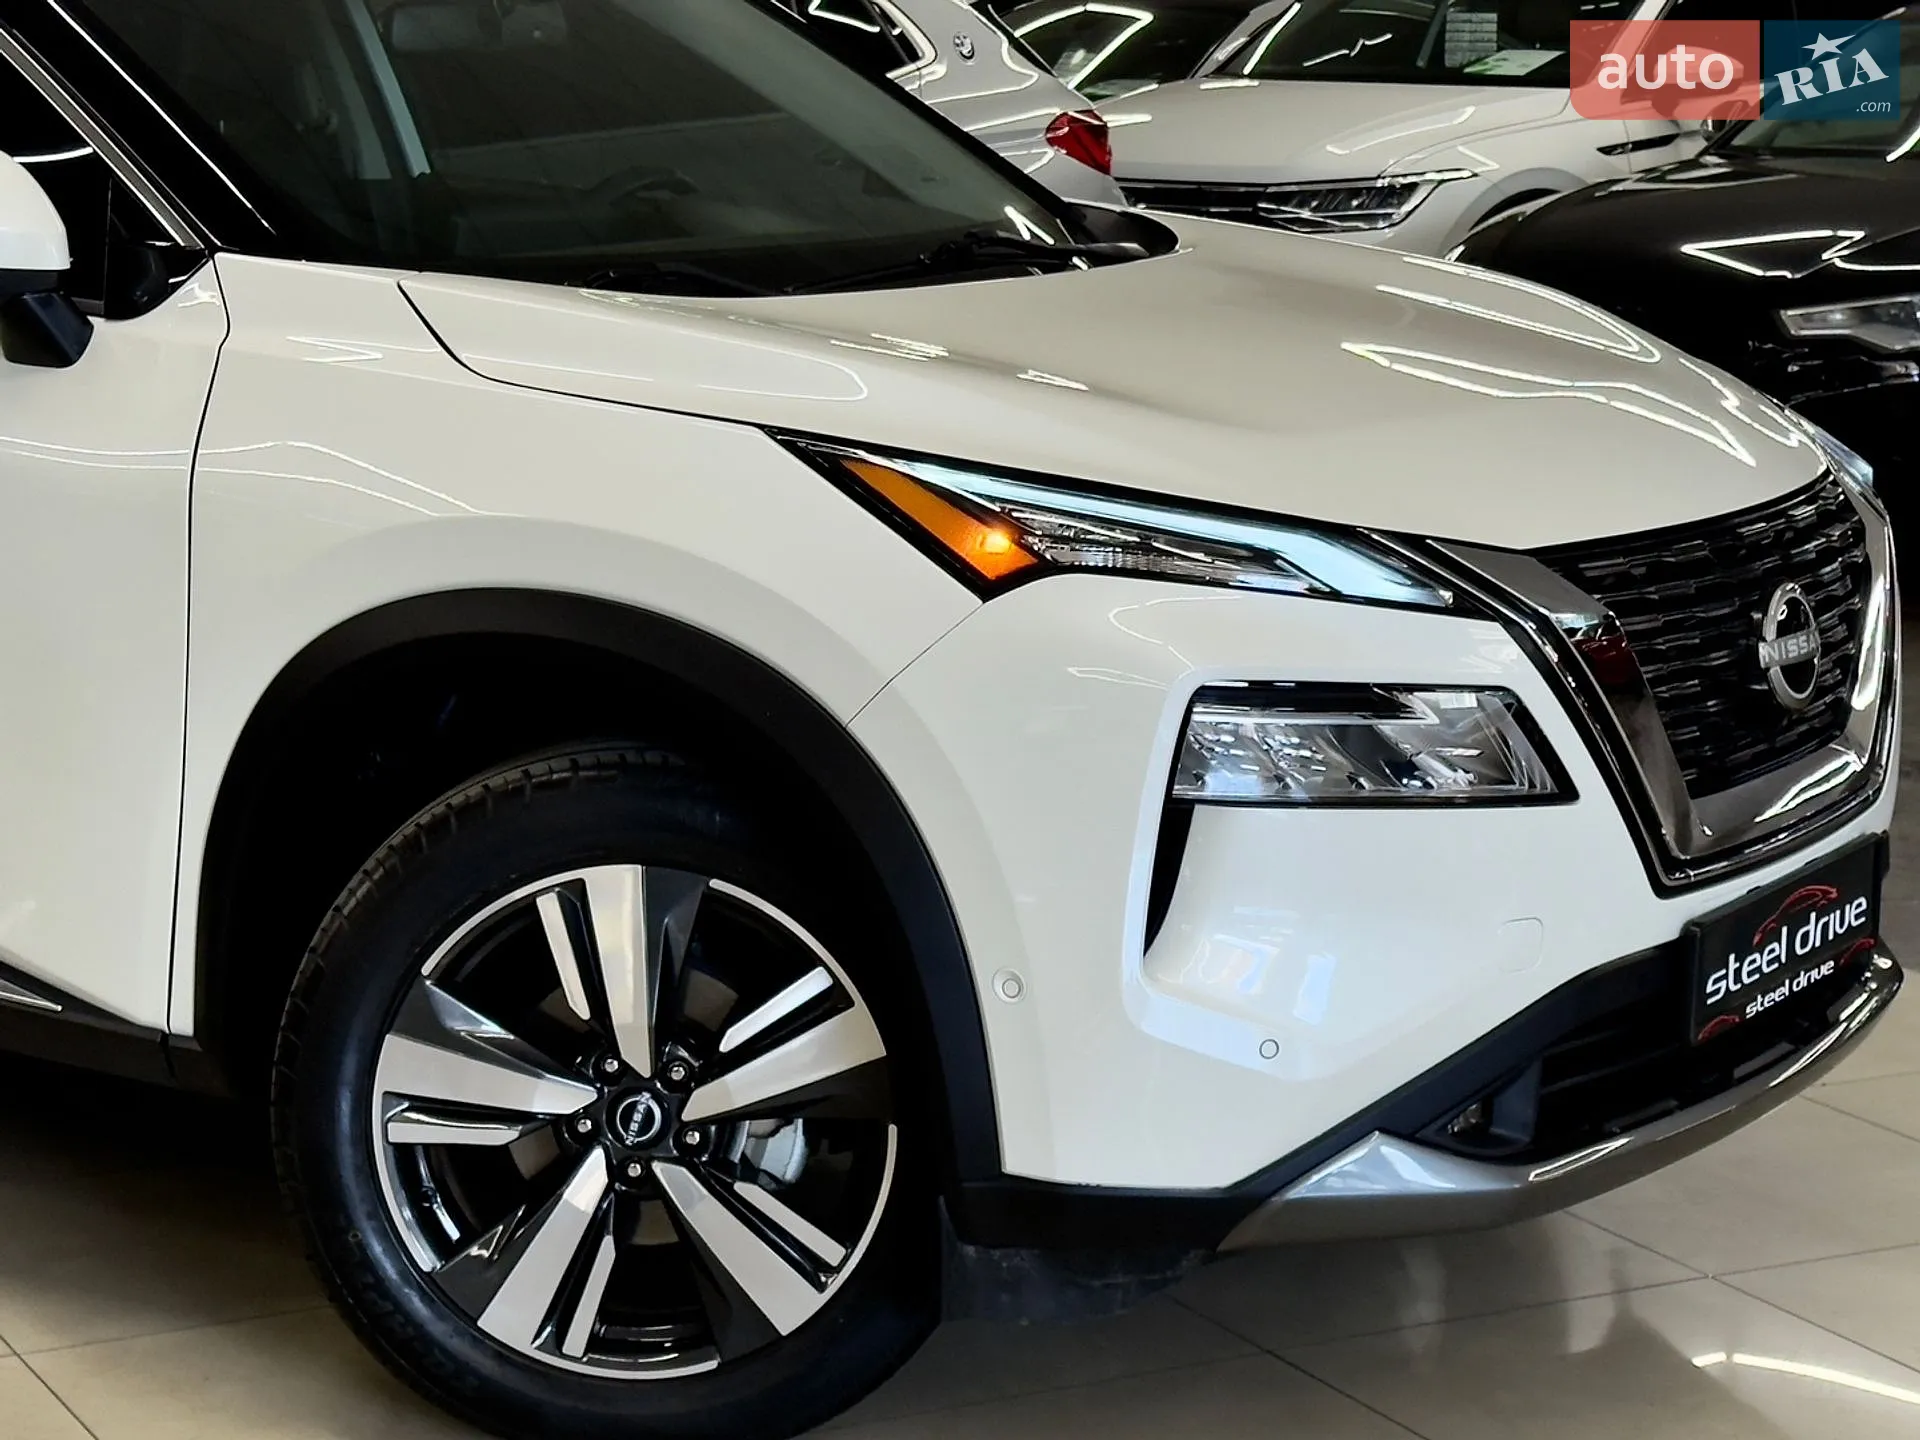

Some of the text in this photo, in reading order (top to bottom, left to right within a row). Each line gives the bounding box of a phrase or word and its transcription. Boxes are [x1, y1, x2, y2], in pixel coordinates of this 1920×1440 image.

[1705, 896, 1868, 1005] steel drive
[1745, 959, 1835, 1019] steel drive
[625, 1091, 652, 1146] NISSAN
